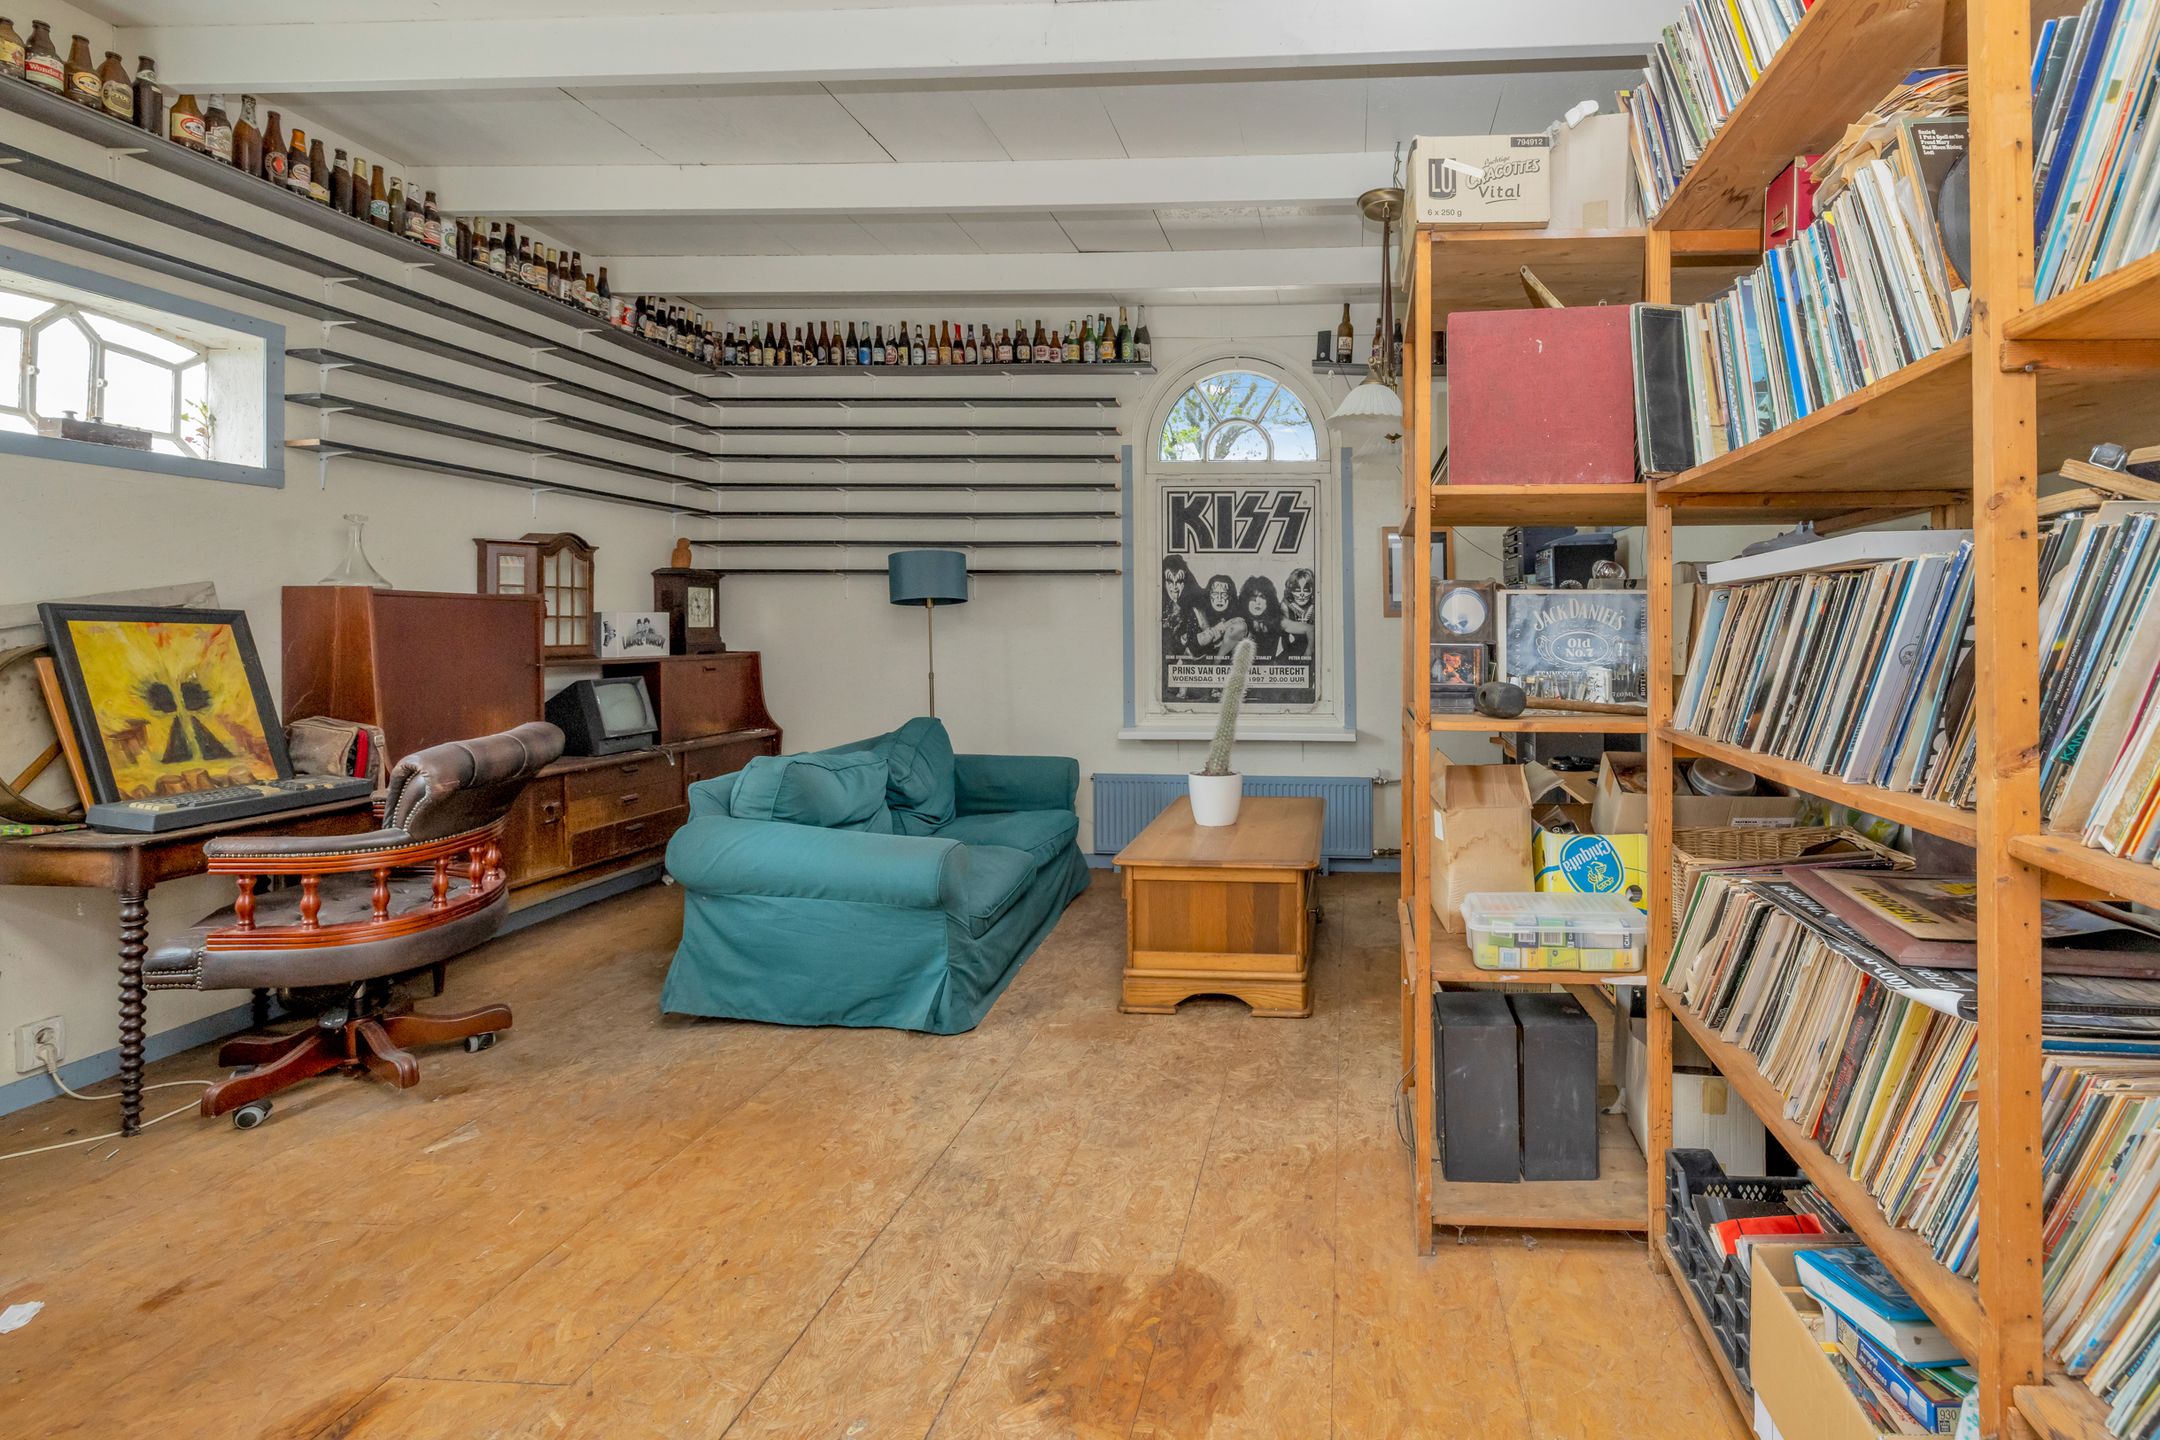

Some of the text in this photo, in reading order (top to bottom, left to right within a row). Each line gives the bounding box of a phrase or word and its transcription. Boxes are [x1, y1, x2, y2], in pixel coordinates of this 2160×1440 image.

[1516, 138, 1543, 146] 794912
[1465, 159, 1541, 190] CACOTTES
[1479, 183, 1521, 198] Vital
[1167, 490, 1311, 554] KISS
[1533, 604, 1568, 631] JACK
[1567, 637, 1591, 648] Old
[1172, 666, 1196, 675] PRINS
[1198, 666, 1214, 675] VAN
[1269, 667, 1306, 675] UTRECHT
[1562, 840, 1612, 872] Chiquita
[1940, 1409, 1957, 1421] 930
